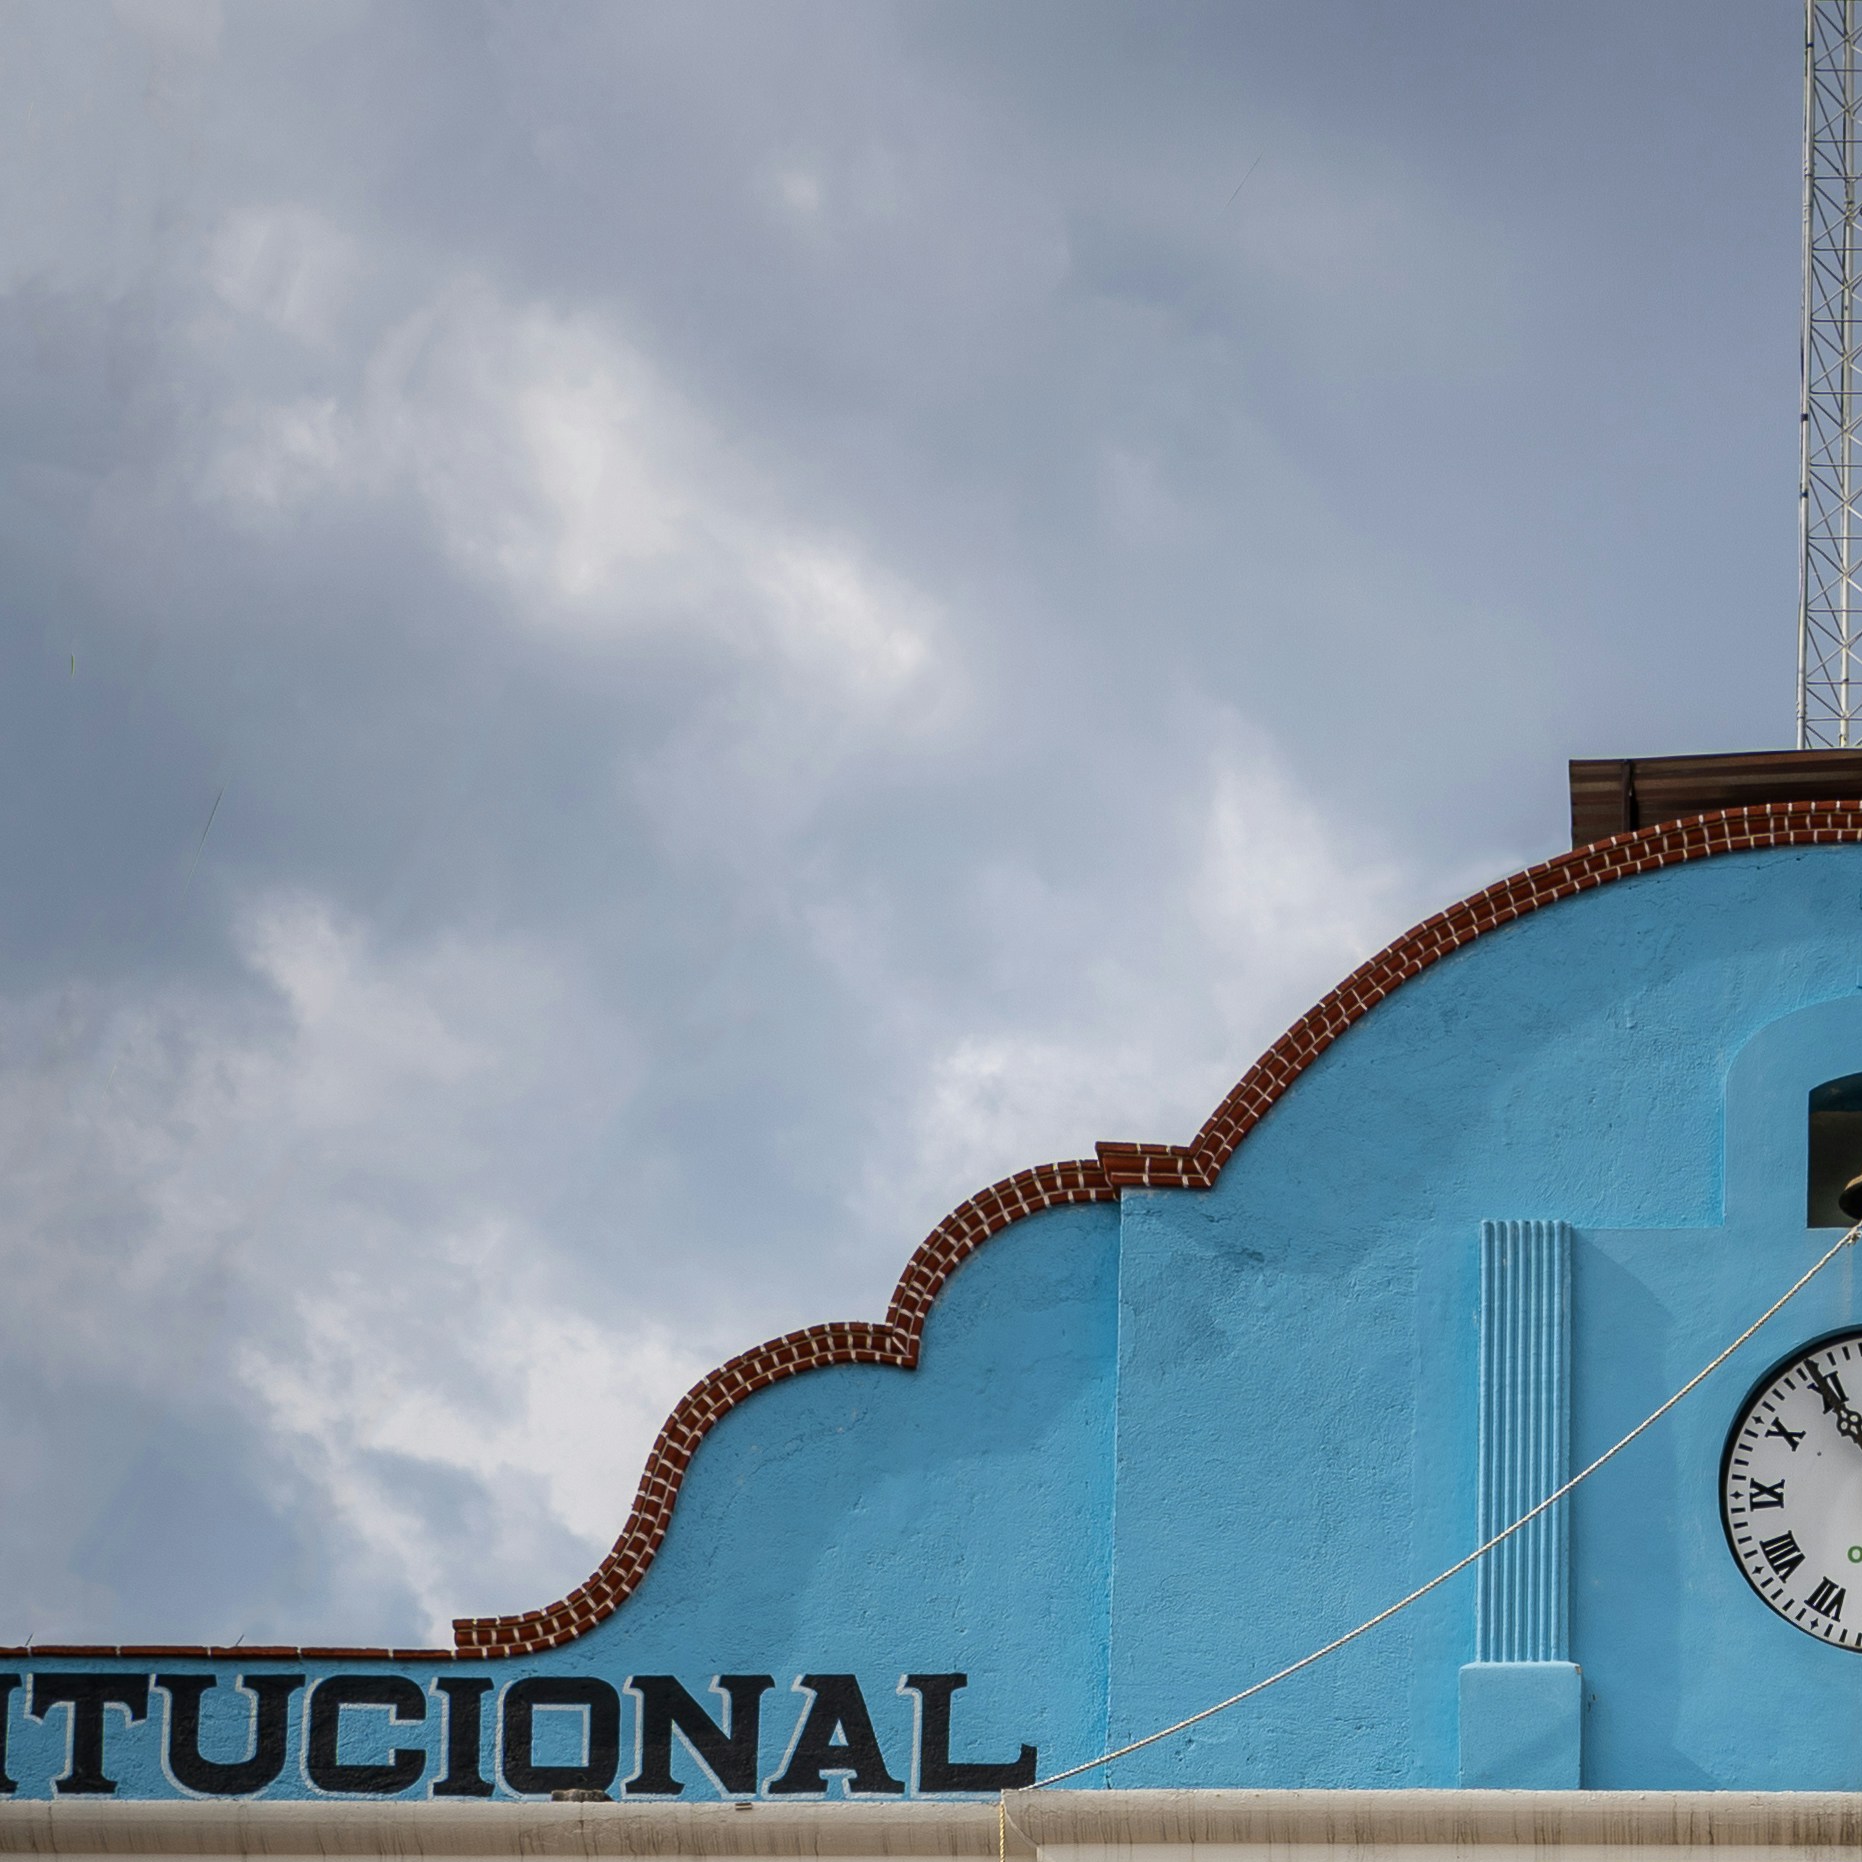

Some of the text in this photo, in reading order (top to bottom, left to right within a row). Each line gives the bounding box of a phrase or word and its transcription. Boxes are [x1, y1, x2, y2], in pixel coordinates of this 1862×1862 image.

[1765, 1417, 1806, 1451] X
[1750, 1478, 1785, 1512] IX
[1759, 1530, 1805, 1583] VIII
[1804, 1577, 1846, 1622] VII
[0, 1673, 1037, 1797] TUCIONAL
